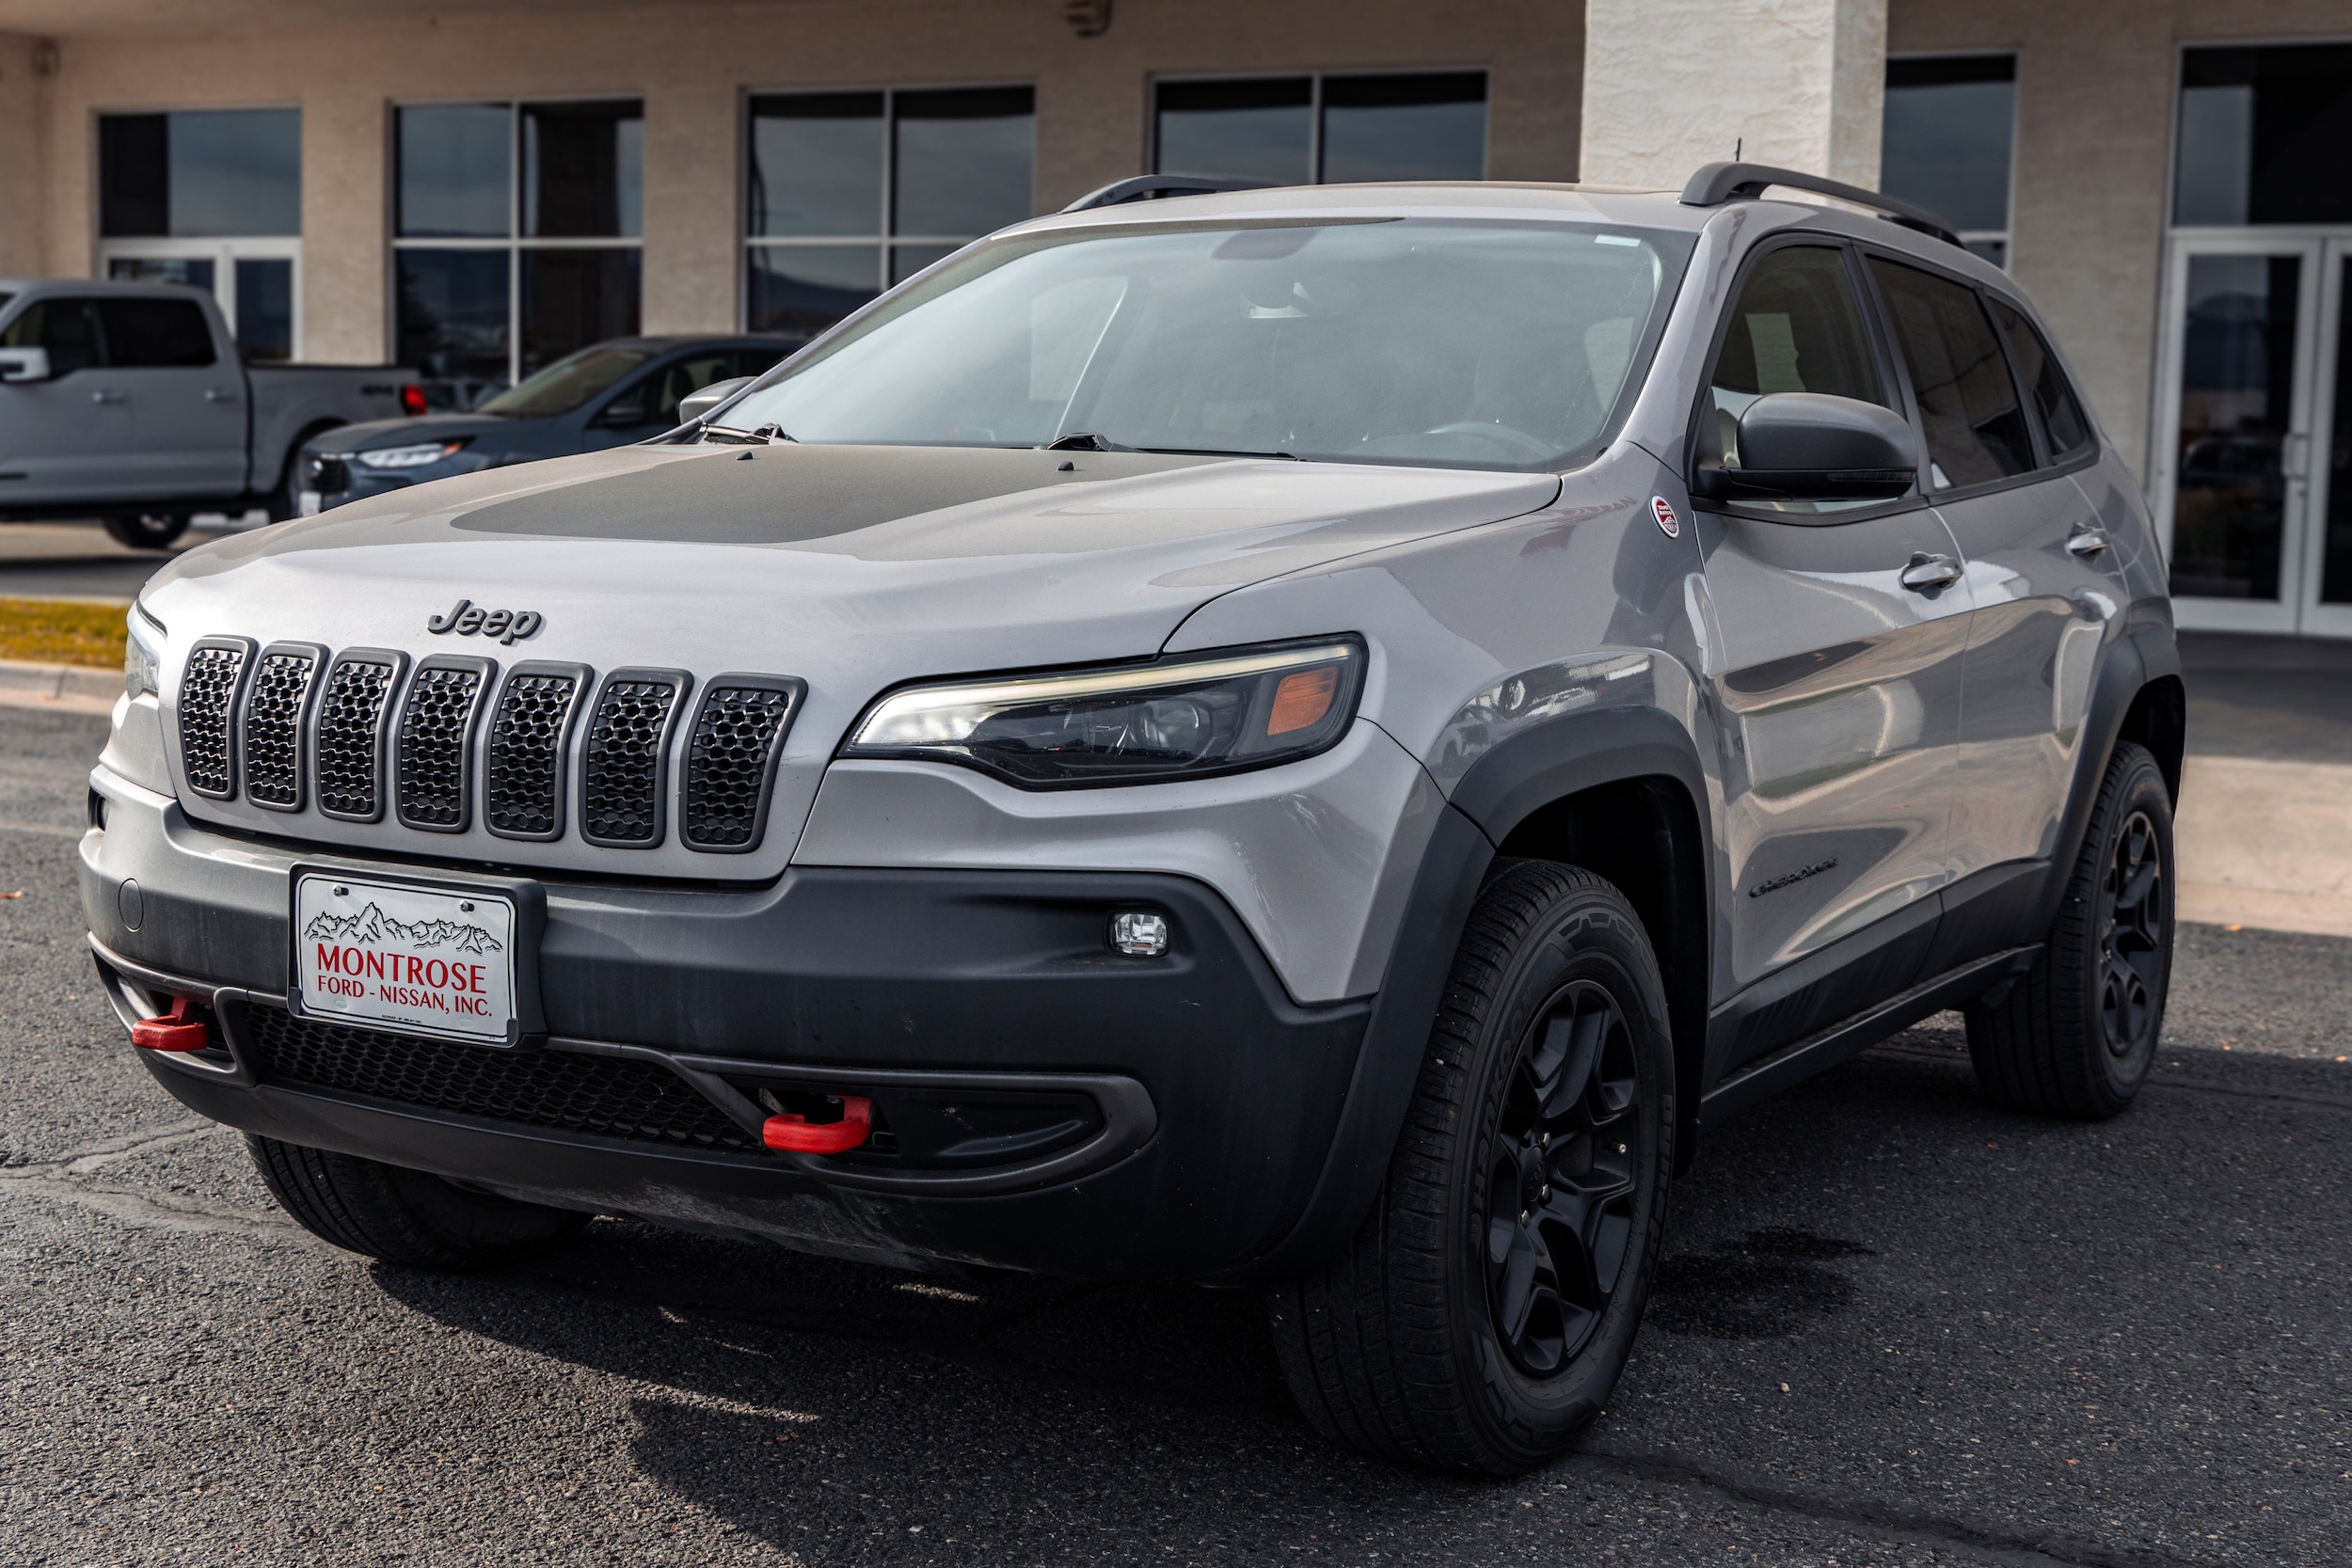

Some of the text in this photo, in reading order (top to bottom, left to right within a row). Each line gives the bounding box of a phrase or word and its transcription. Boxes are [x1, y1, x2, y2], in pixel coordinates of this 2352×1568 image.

[427, 599, 542, 645] Jeep
[317, 942, 487, 994] MONTROSE
[317, 974, 365, 998] FORD
[380, 984, 450, 1017] NISSAN,
[454, 994, 493, 1017] INC.
